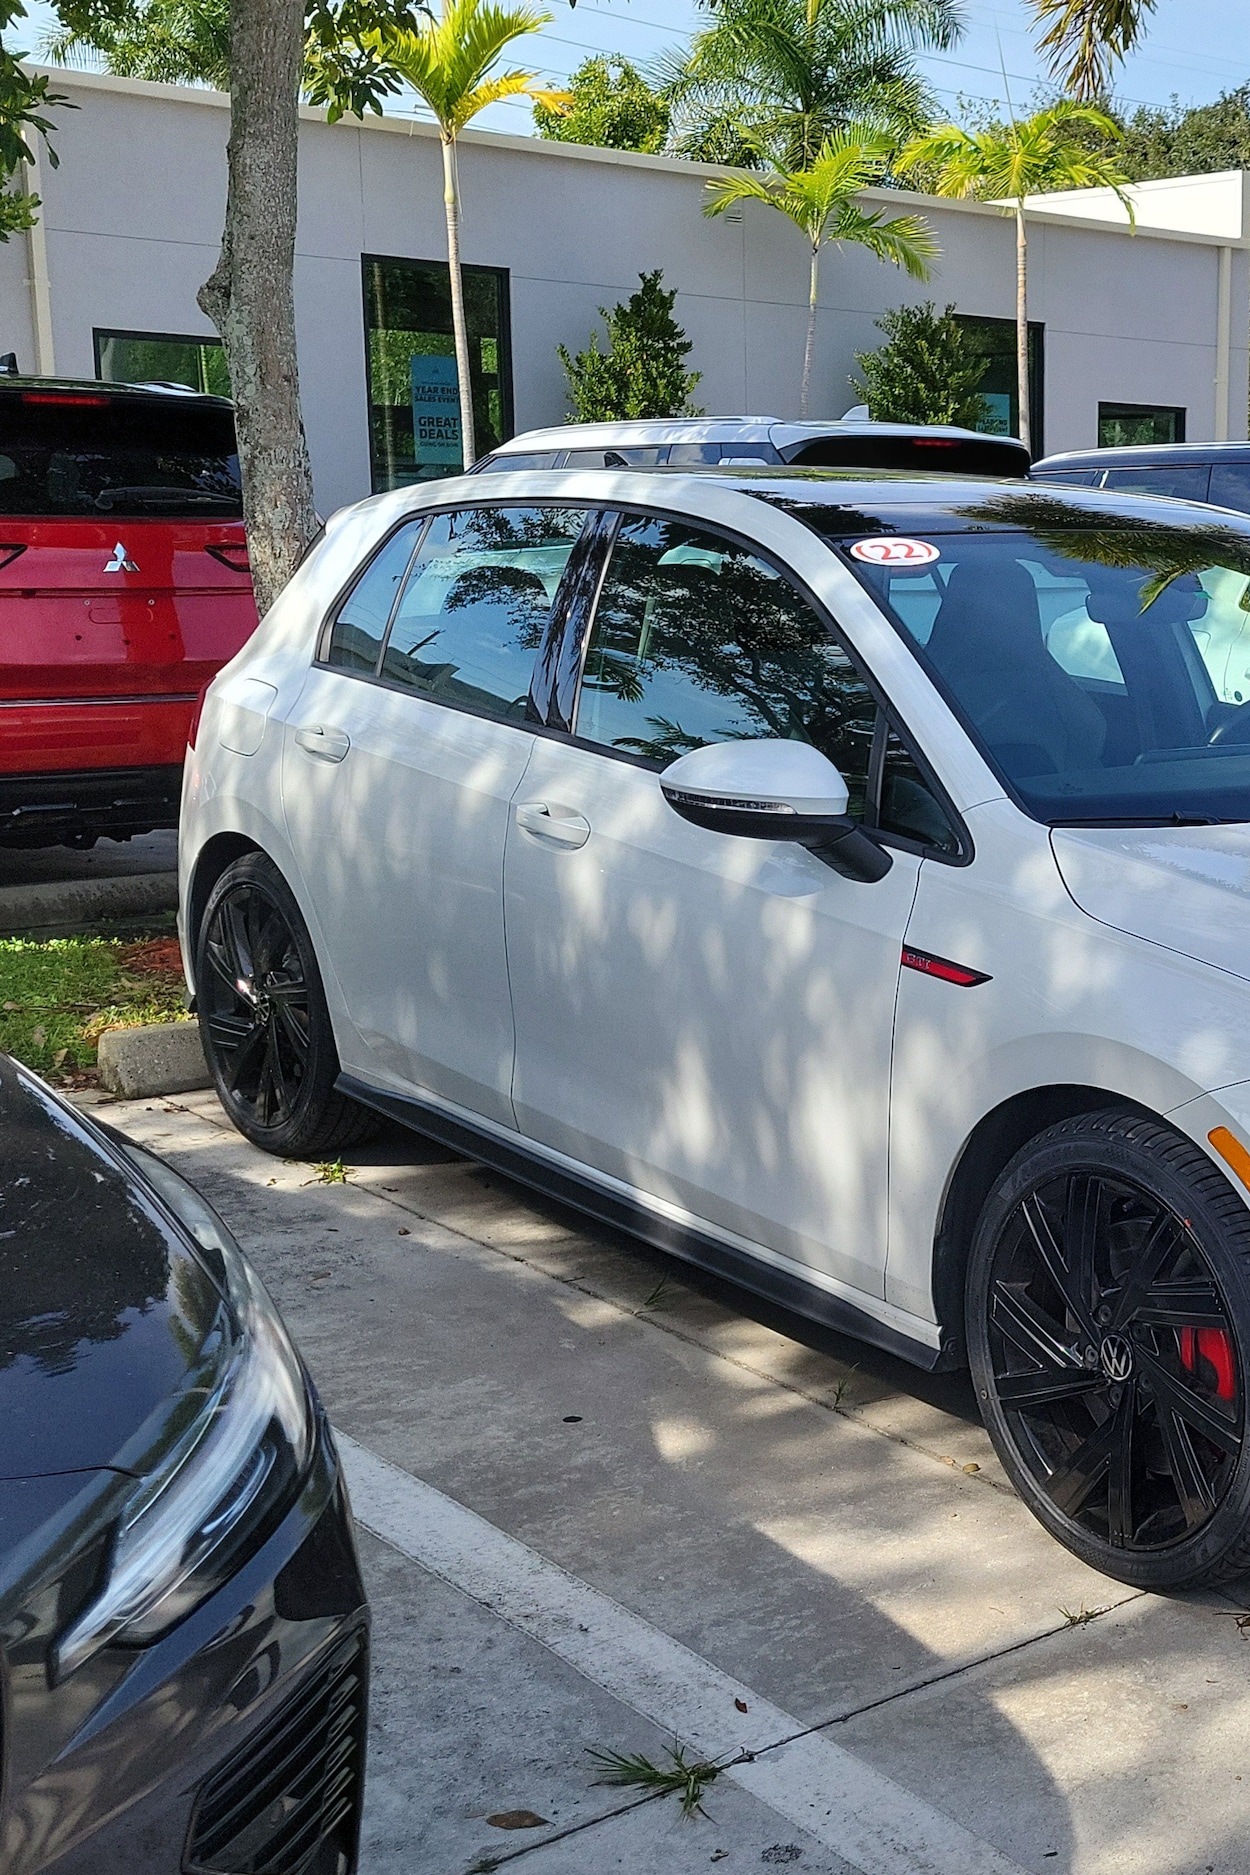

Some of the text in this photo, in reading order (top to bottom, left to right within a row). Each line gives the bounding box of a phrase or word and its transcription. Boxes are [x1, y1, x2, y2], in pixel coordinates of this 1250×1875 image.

[415, 386, 458, 395] YEAR END
[418, 416, 459, 428] GREAT
[419, 428, 459, 440] DEALS
[905, 954, 931, 969] GTI
